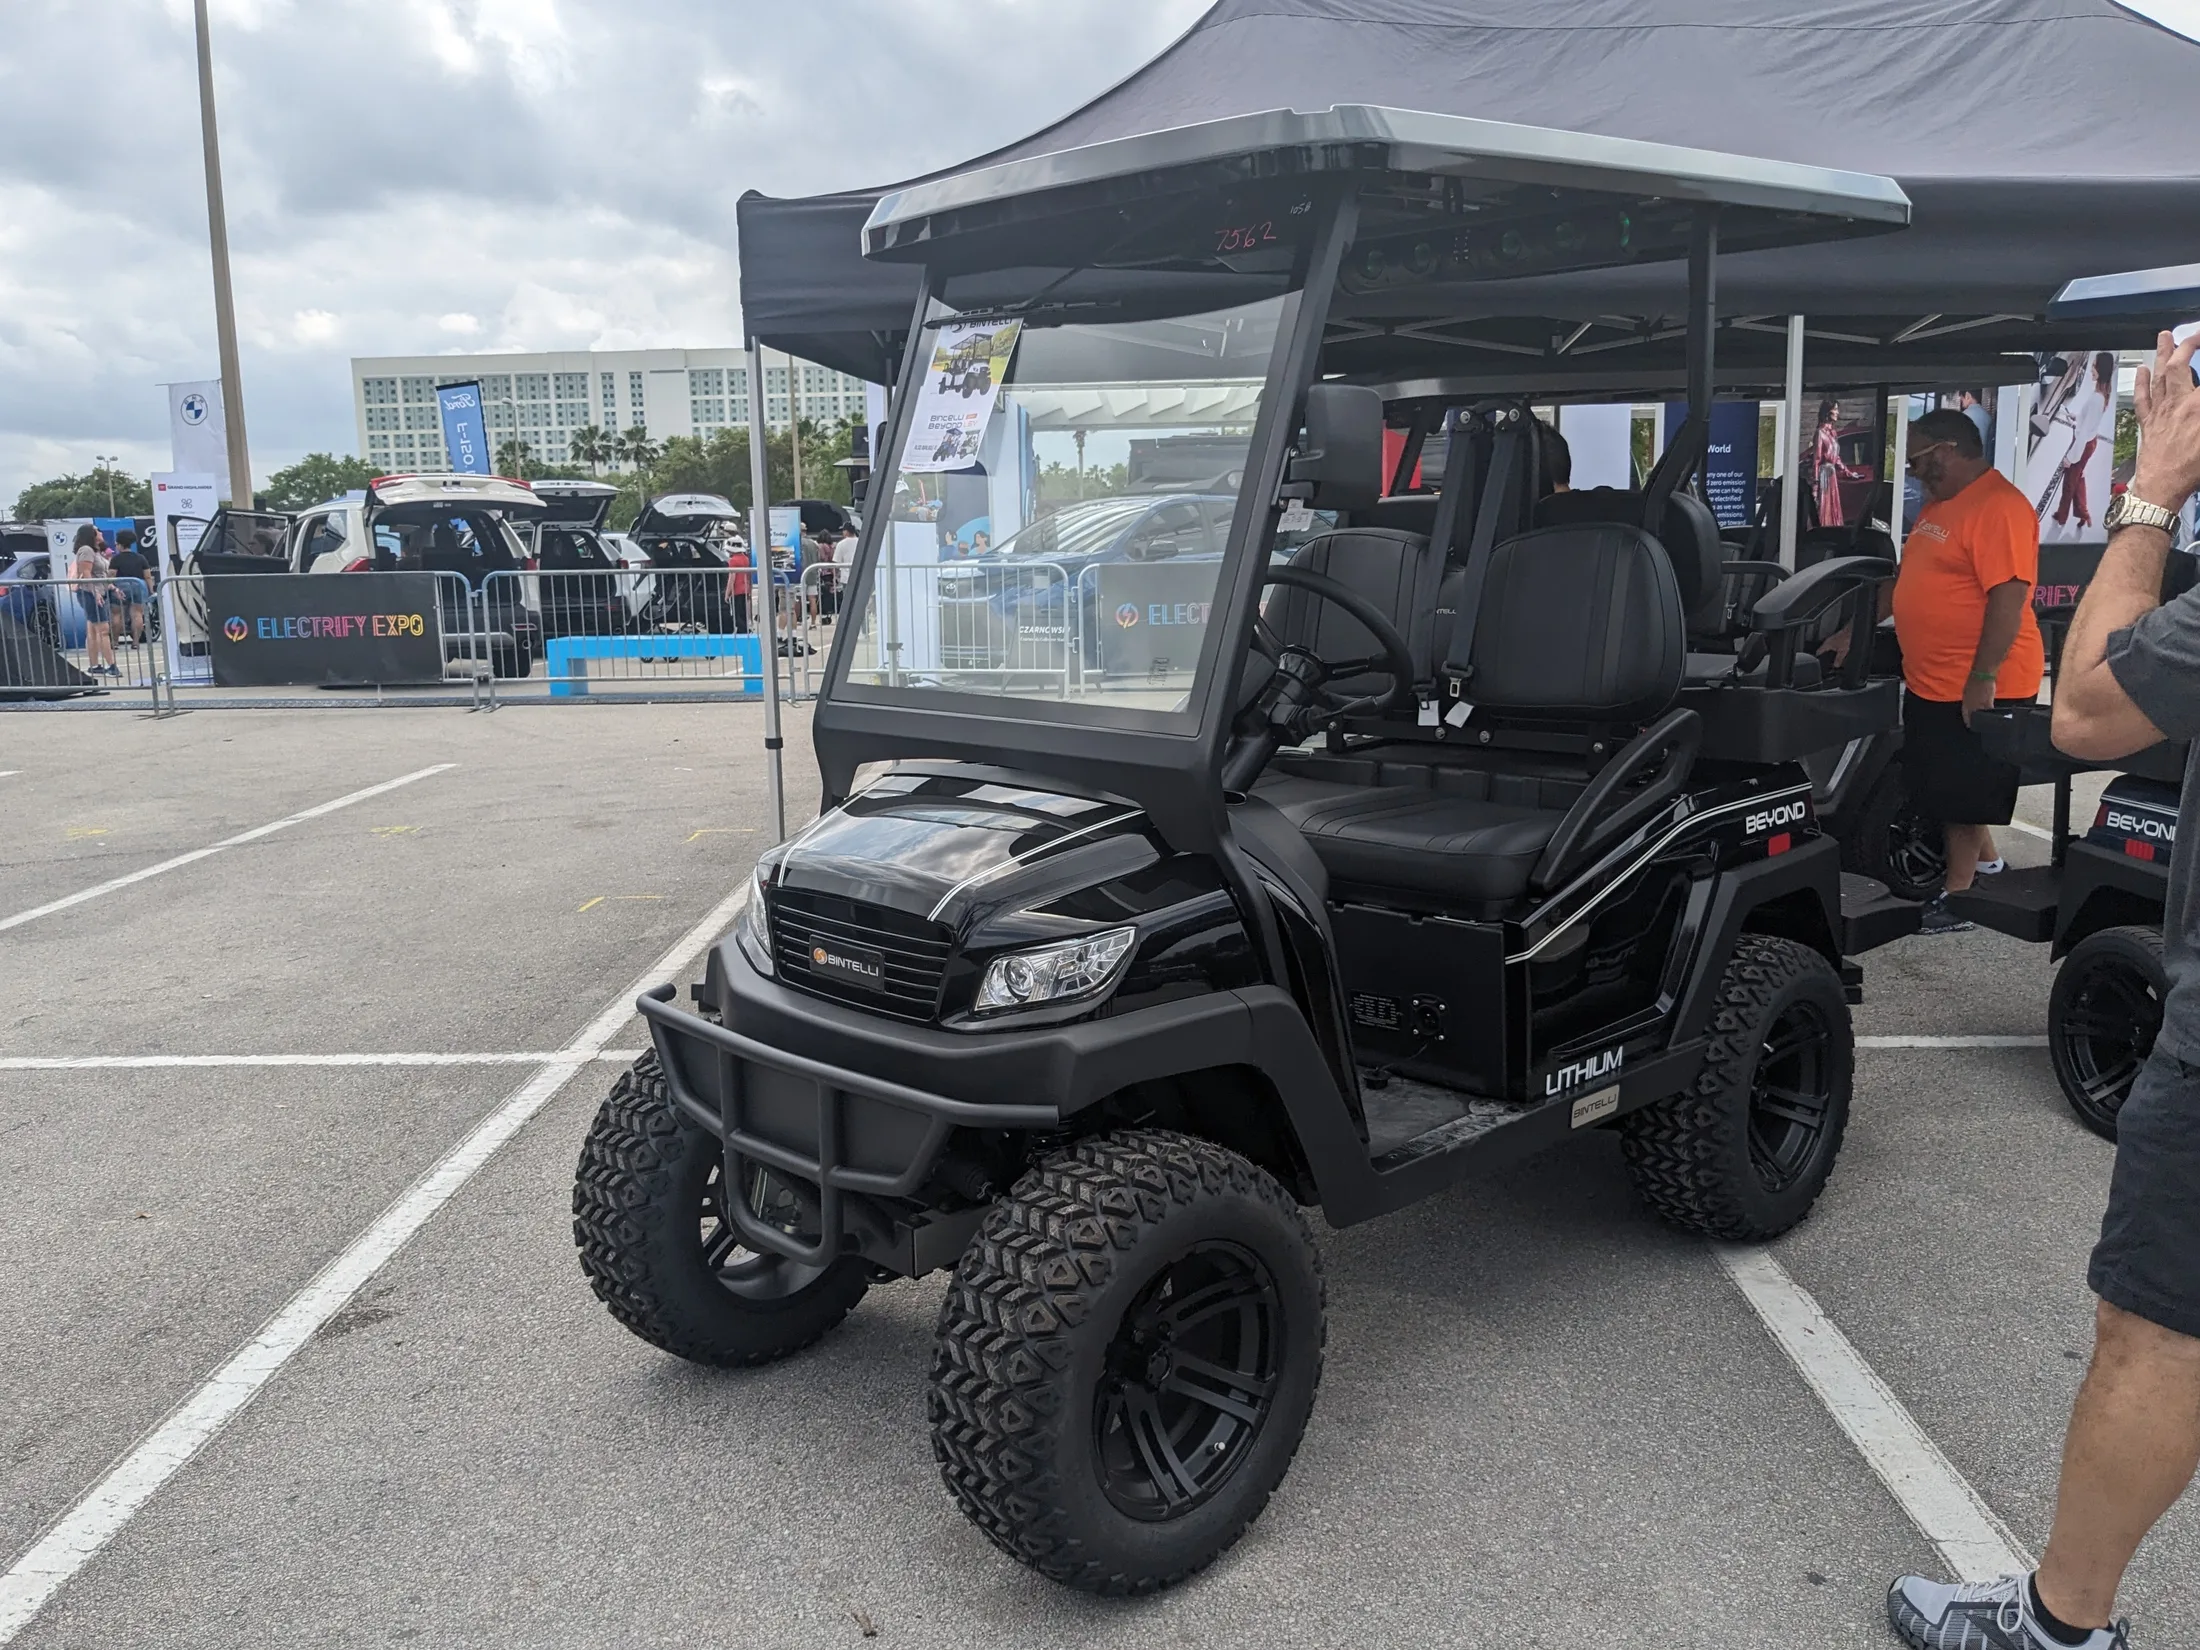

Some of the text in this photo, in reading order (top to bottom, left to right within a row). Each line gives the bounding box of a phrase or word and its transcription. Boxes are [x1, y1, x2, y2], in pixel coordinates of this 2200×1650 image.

[1214, 221, 1277, 252] 7562
[1707, 444, 1731, 453] World
[1731, 487, 1744, 495] help
[2034, 584, 2080, 607] RIFY
[256, 613, 424, 639] ELECTRIFY EXPO
[1148, 602, 1212, 626] ELECT
[1745, 801, 1806, 835] BEYOND
[2106, 811, 2176, 842] BEYON
[827, 954, 879, 977] BINTELLI
[1545, 1045, 1624, 1096] LITHIUM
[1573, 1093, 1617, 1119] BINTELLI
